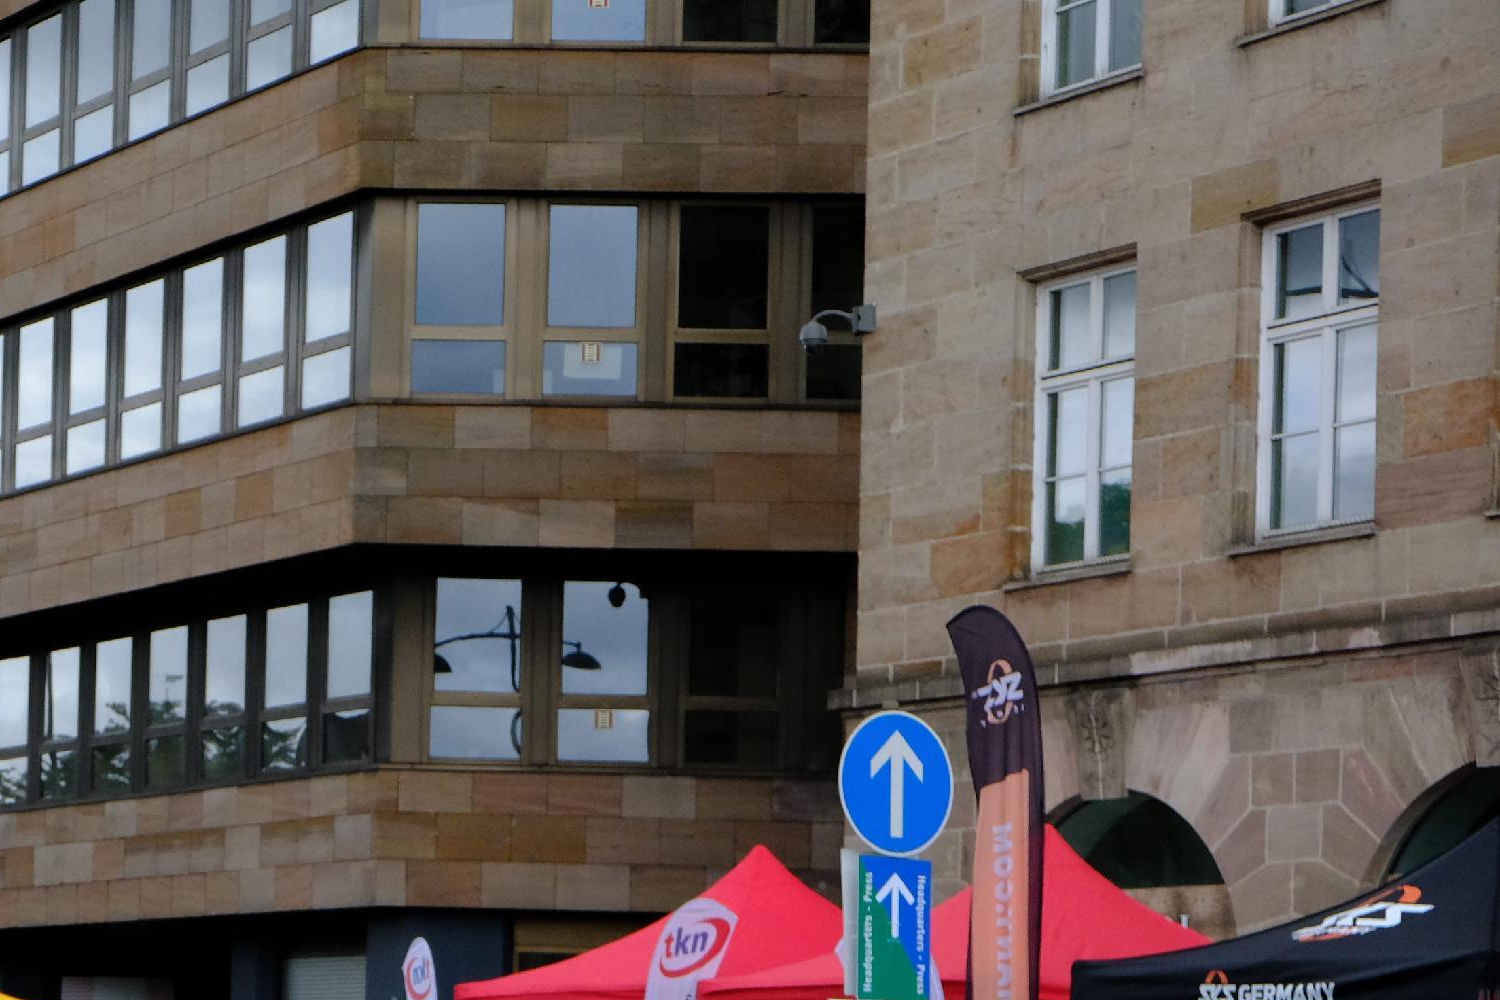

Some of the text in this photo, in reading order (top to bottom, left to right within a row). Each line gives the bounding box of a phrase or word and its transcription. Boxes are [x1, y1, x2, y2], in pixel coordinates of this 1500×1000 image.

[863, 871, 873, 902] Press
[916, 875, 926, 952] Headquarters
[664, 927, 709, 959] tkn
[863, 914, 874, 993] Headquarters
[916, 964, 926, 995] Press
